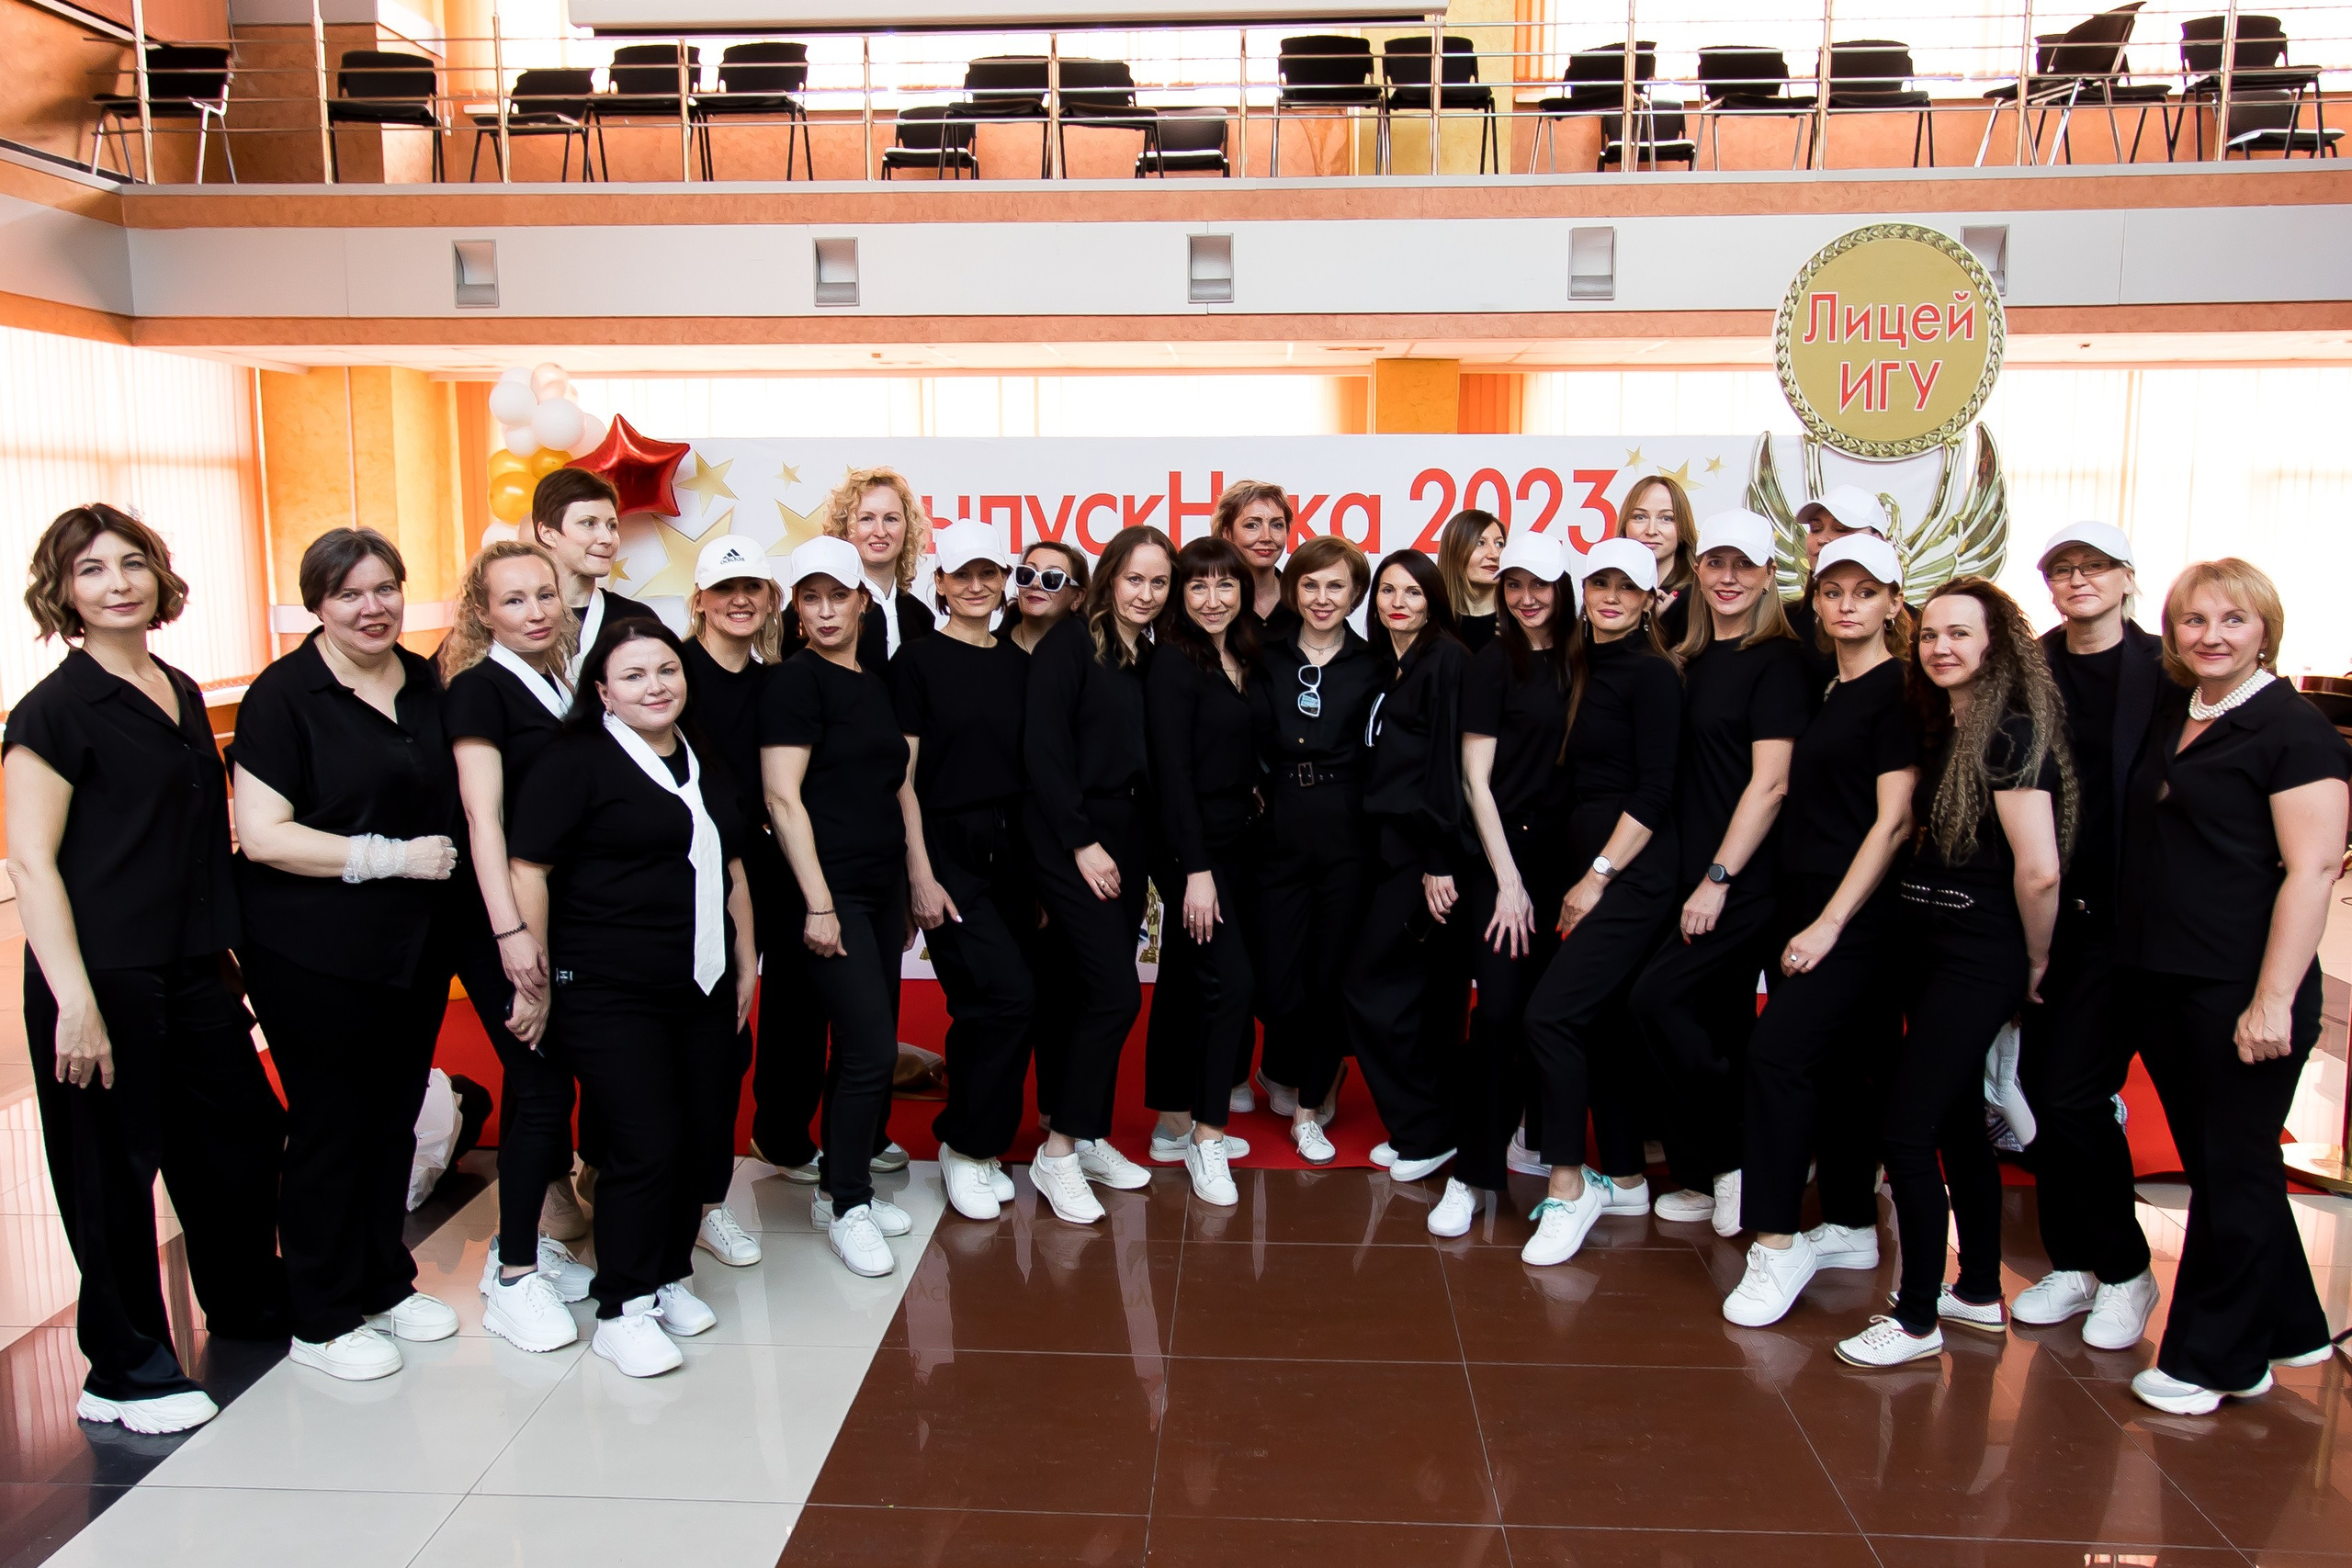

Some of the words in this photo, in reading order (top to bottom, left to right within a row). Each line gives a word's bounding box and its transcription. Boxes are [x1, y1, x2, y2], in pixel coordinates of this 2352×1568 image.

[1803, 290, 1975, 350] Лицей
[1839, 358, 1943, 415] ИГУ
[920, 470, 1380, 556] ыпускНка
[1409, 468, 1619, 556] 2023
